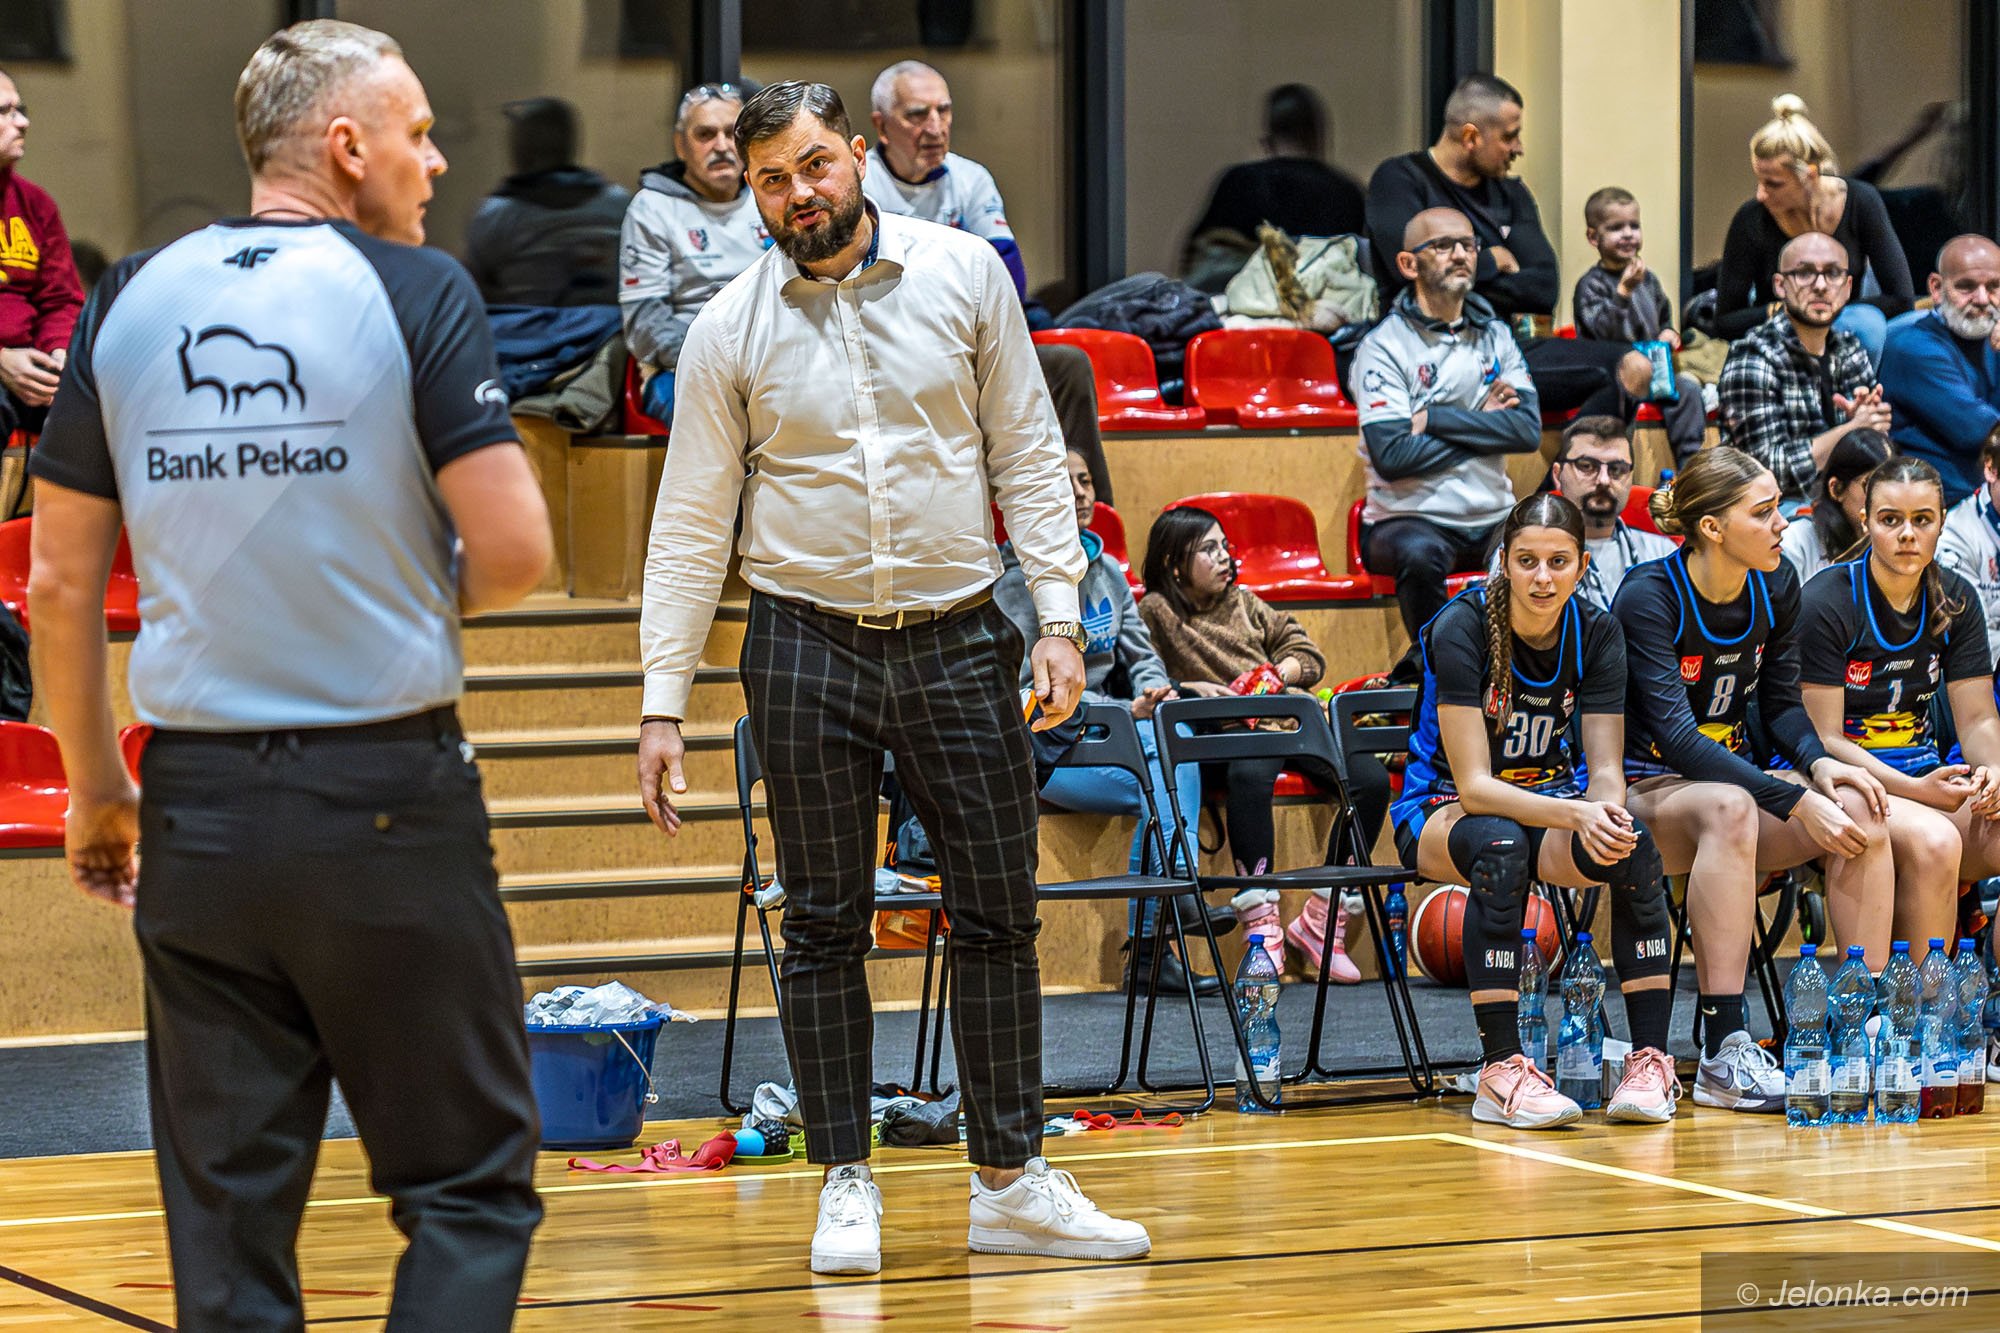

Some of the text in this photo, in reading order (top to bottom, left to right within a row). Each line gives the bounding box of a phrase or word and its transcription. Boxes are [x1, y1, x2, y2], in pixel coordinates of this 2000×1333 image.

[222, 246, 278, 269] 4F
[147, 440, 349, 481] Bank Pekao
[1707, 674, 1736, 717] 8
[1503, 712, 1555, 757] 30
[1495, 951, 1515, 969] NBA
[1646, 938, 1667, 958] NBA
